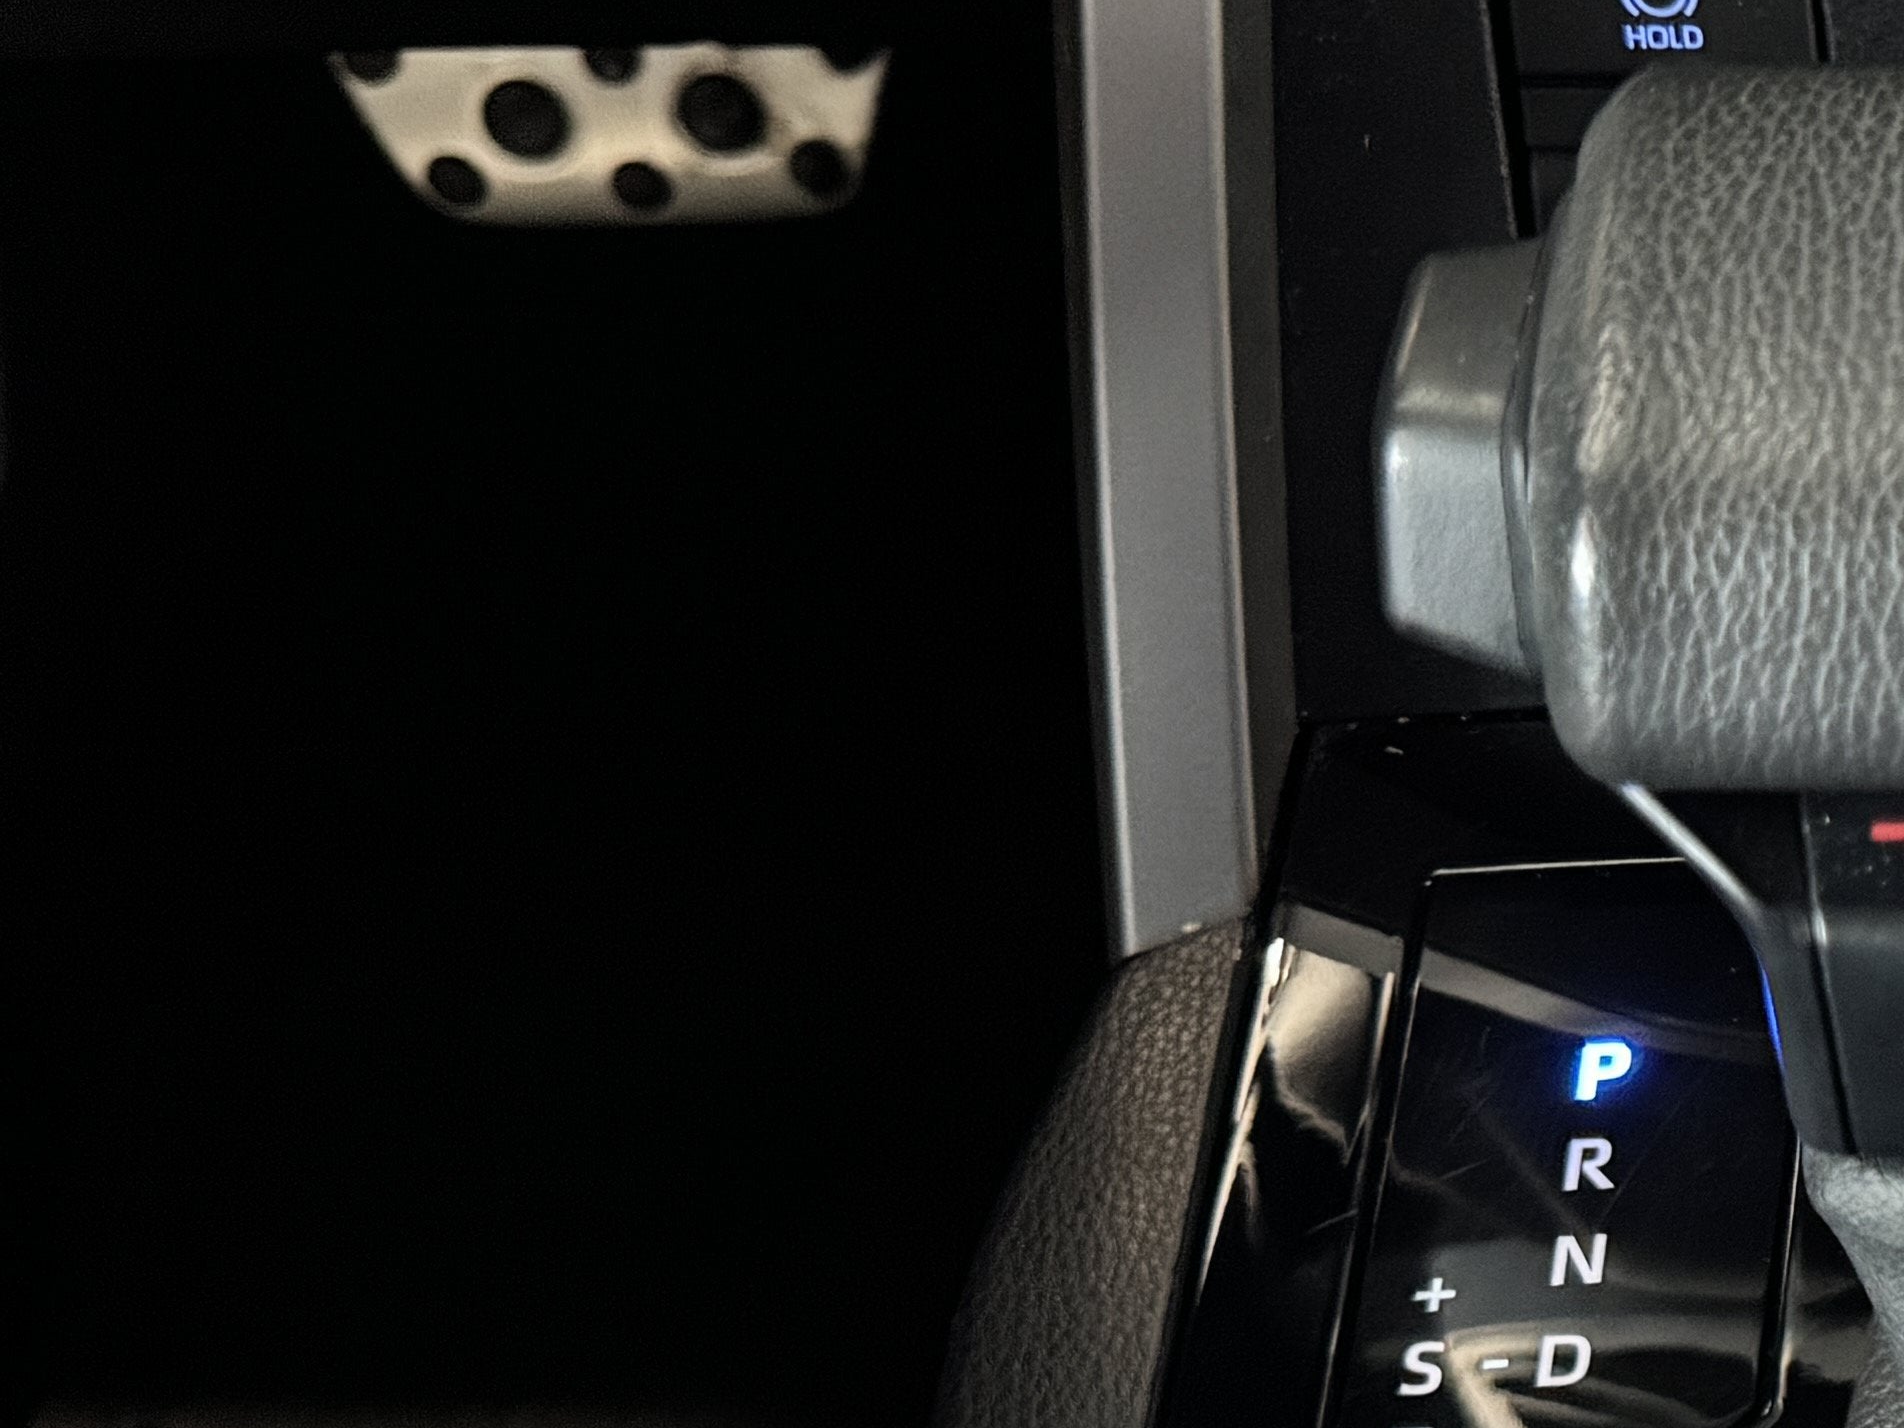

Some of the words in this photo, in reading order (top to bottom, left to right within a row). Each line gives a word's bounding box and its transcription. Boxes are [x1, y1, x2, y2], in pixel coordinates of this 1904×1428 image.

[1622, 23, 1705, 51] HOLD
[1573, 1038, 1633, 1102] P
[1561, 1137, 1616, 1192] R
[1549, 1233, 1608, 1287] N
[1396, 1340, 1446, 1397] S
[1534, 1334, 1592, 1389] D
